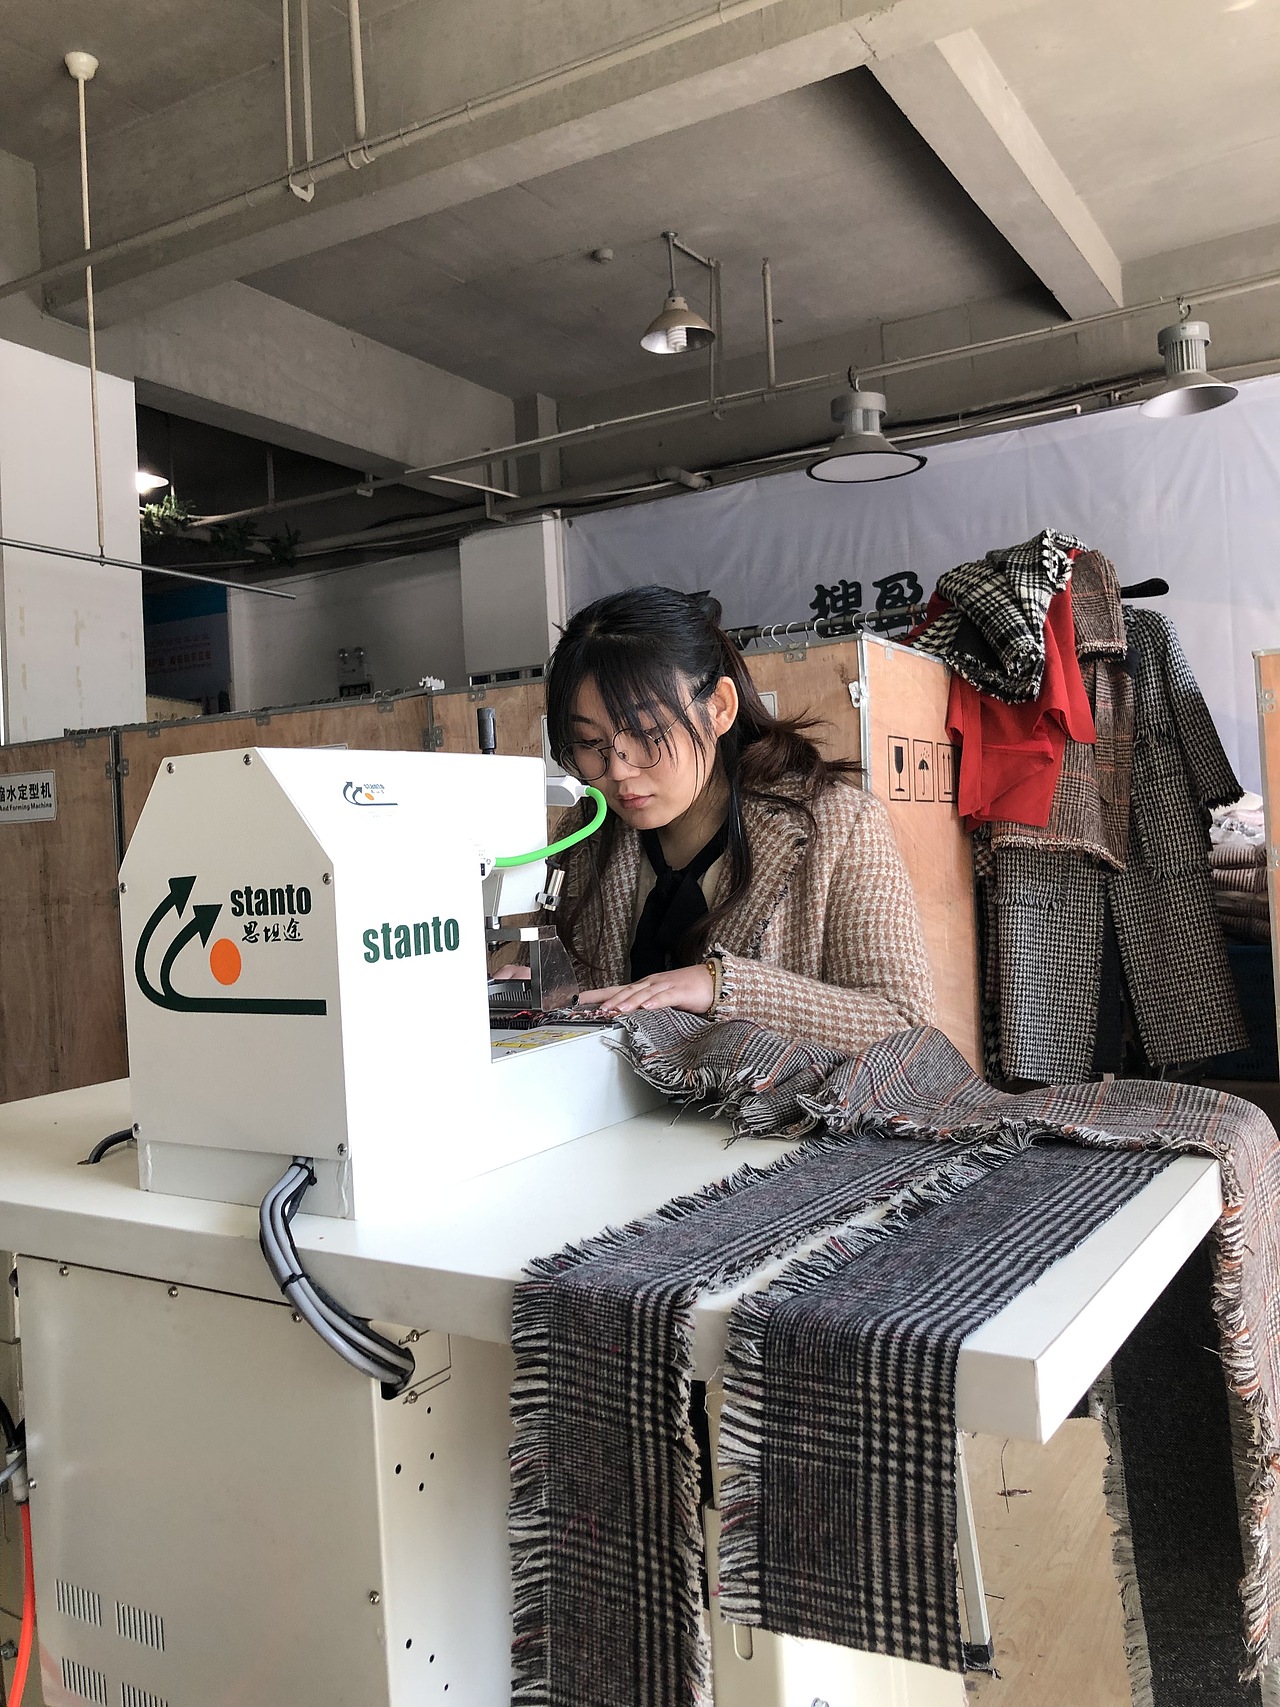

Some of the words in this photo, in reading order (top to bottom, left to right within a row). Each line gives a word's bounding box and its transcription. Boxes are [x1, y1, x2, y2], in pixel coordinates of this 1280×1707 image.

[30, 802, 52, 810] Machine
[230, 884, 312, 917] stanto
[241, 917, 304, 943] 思坦途
[362, 916, 460, 963] stanto
